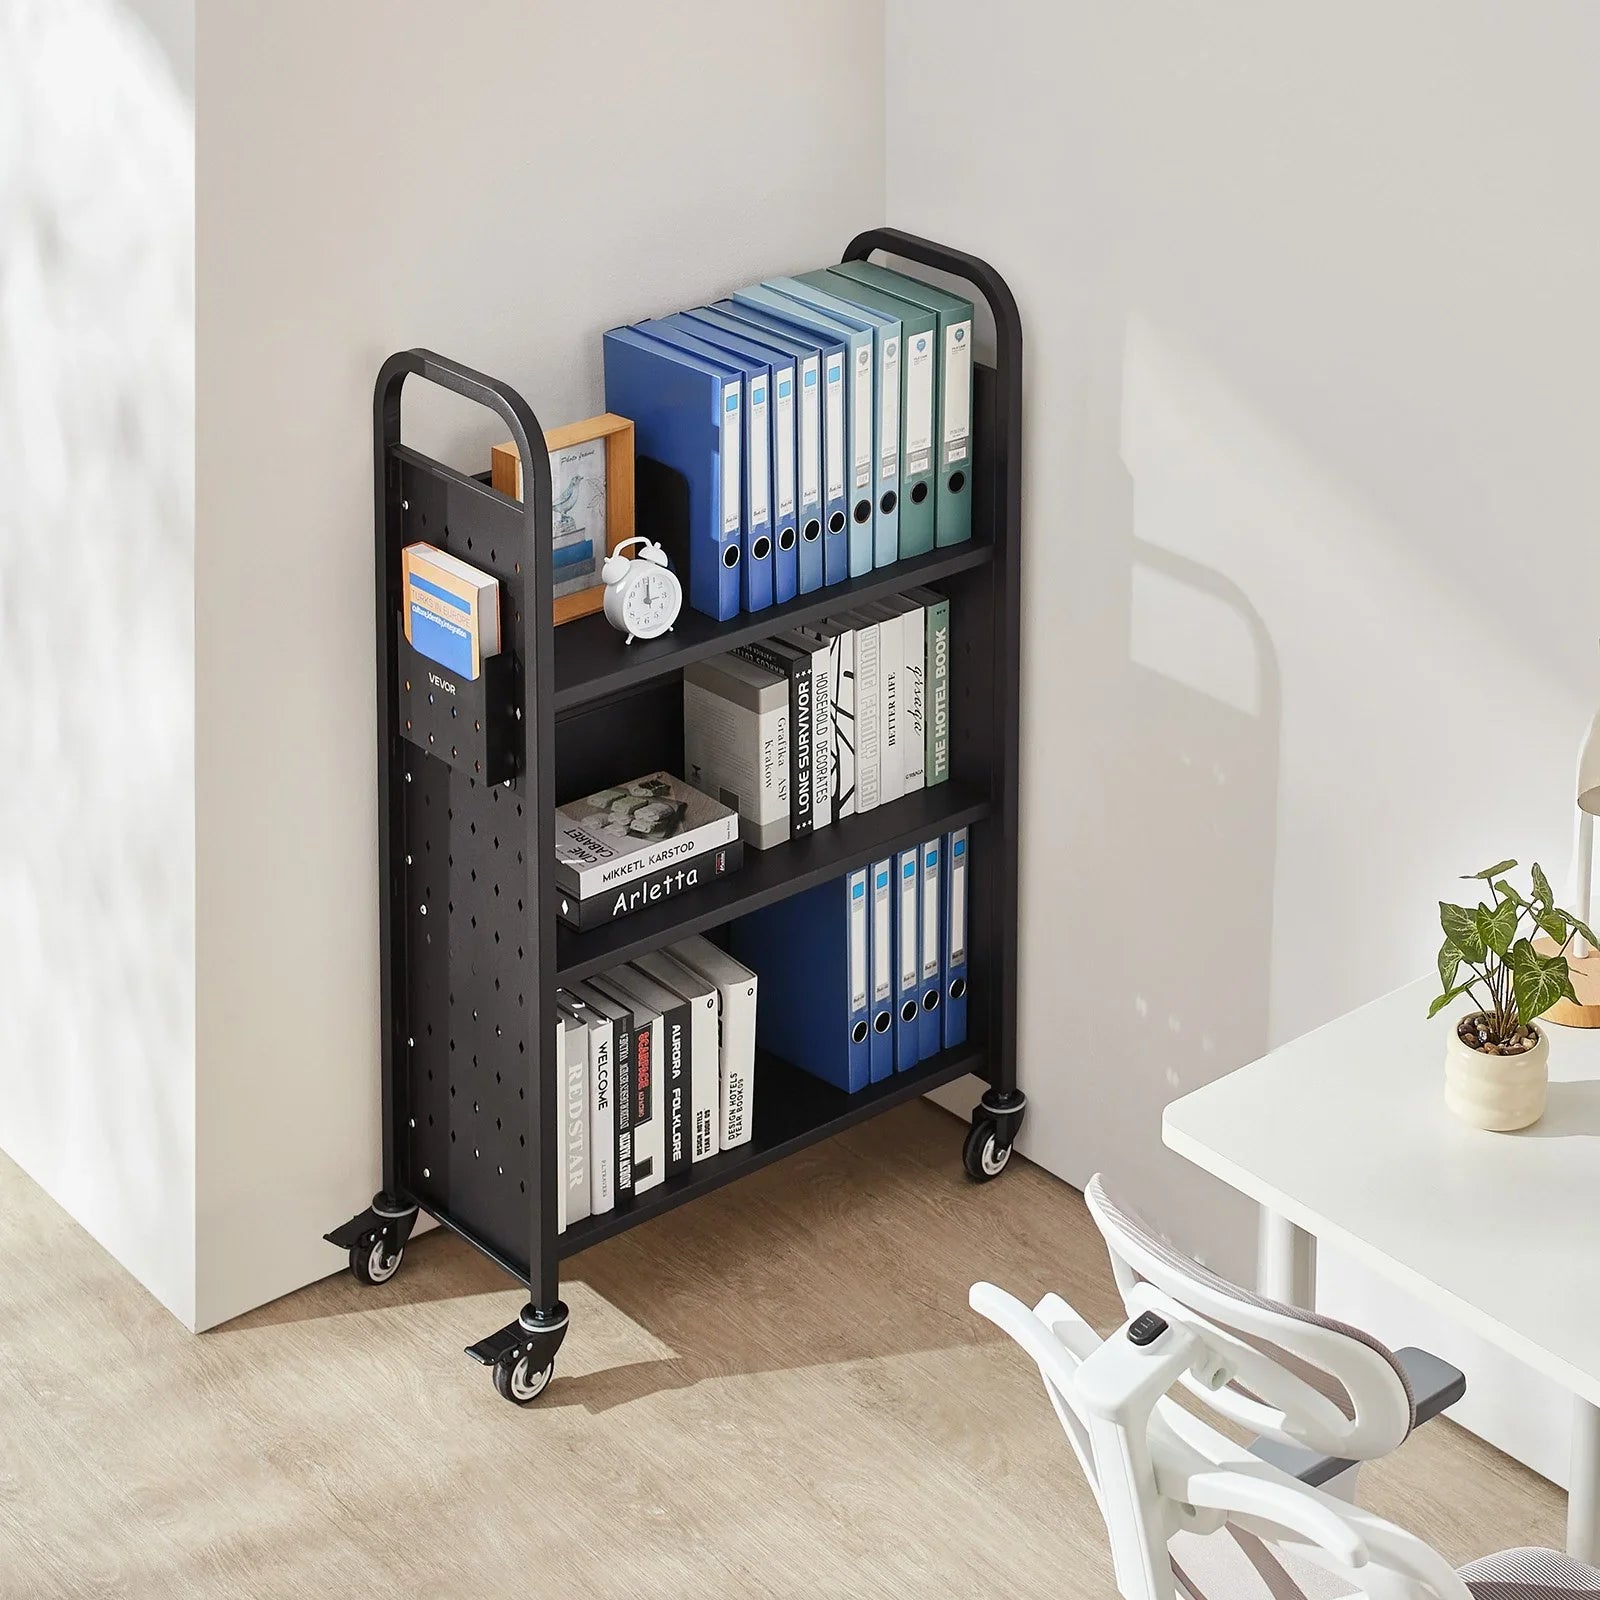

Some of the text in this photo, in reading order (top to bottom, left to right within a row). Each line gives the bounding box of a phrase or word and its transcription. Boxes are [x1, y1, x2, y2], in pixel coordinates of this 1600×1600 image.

[935, 627, 946, 680] BOOK
[428, 672, 456, 695] VEVOR
[935, 680, 946, 738] HOTEL
[888, 672, 896, 747] BETTER LIFE
[765, 739, 773, 788] Krakow
[778, 717, 786, 767] Grafika
[798, 680, 810, 815] LONE SURVIVOR
[816, 672, 828, 804] HOUSEHOLD DECORATES
[935, 738, 946, 776] THE
[563, 829, 613, 858] CABARET
[602, 860, 645, 883] MIKKETL
[648, 841, 695, 866] KARSTOD
[612, 869, 698, 916] Arletta
[598, 1040, 608, 1111] WELCOME
[672, 1024, 682, 1162] AURORA FOLKLORE
[728, 1072, 737, 1140] DESIGN HOTELS
[735, 1114, 743, 1138] YEAR
